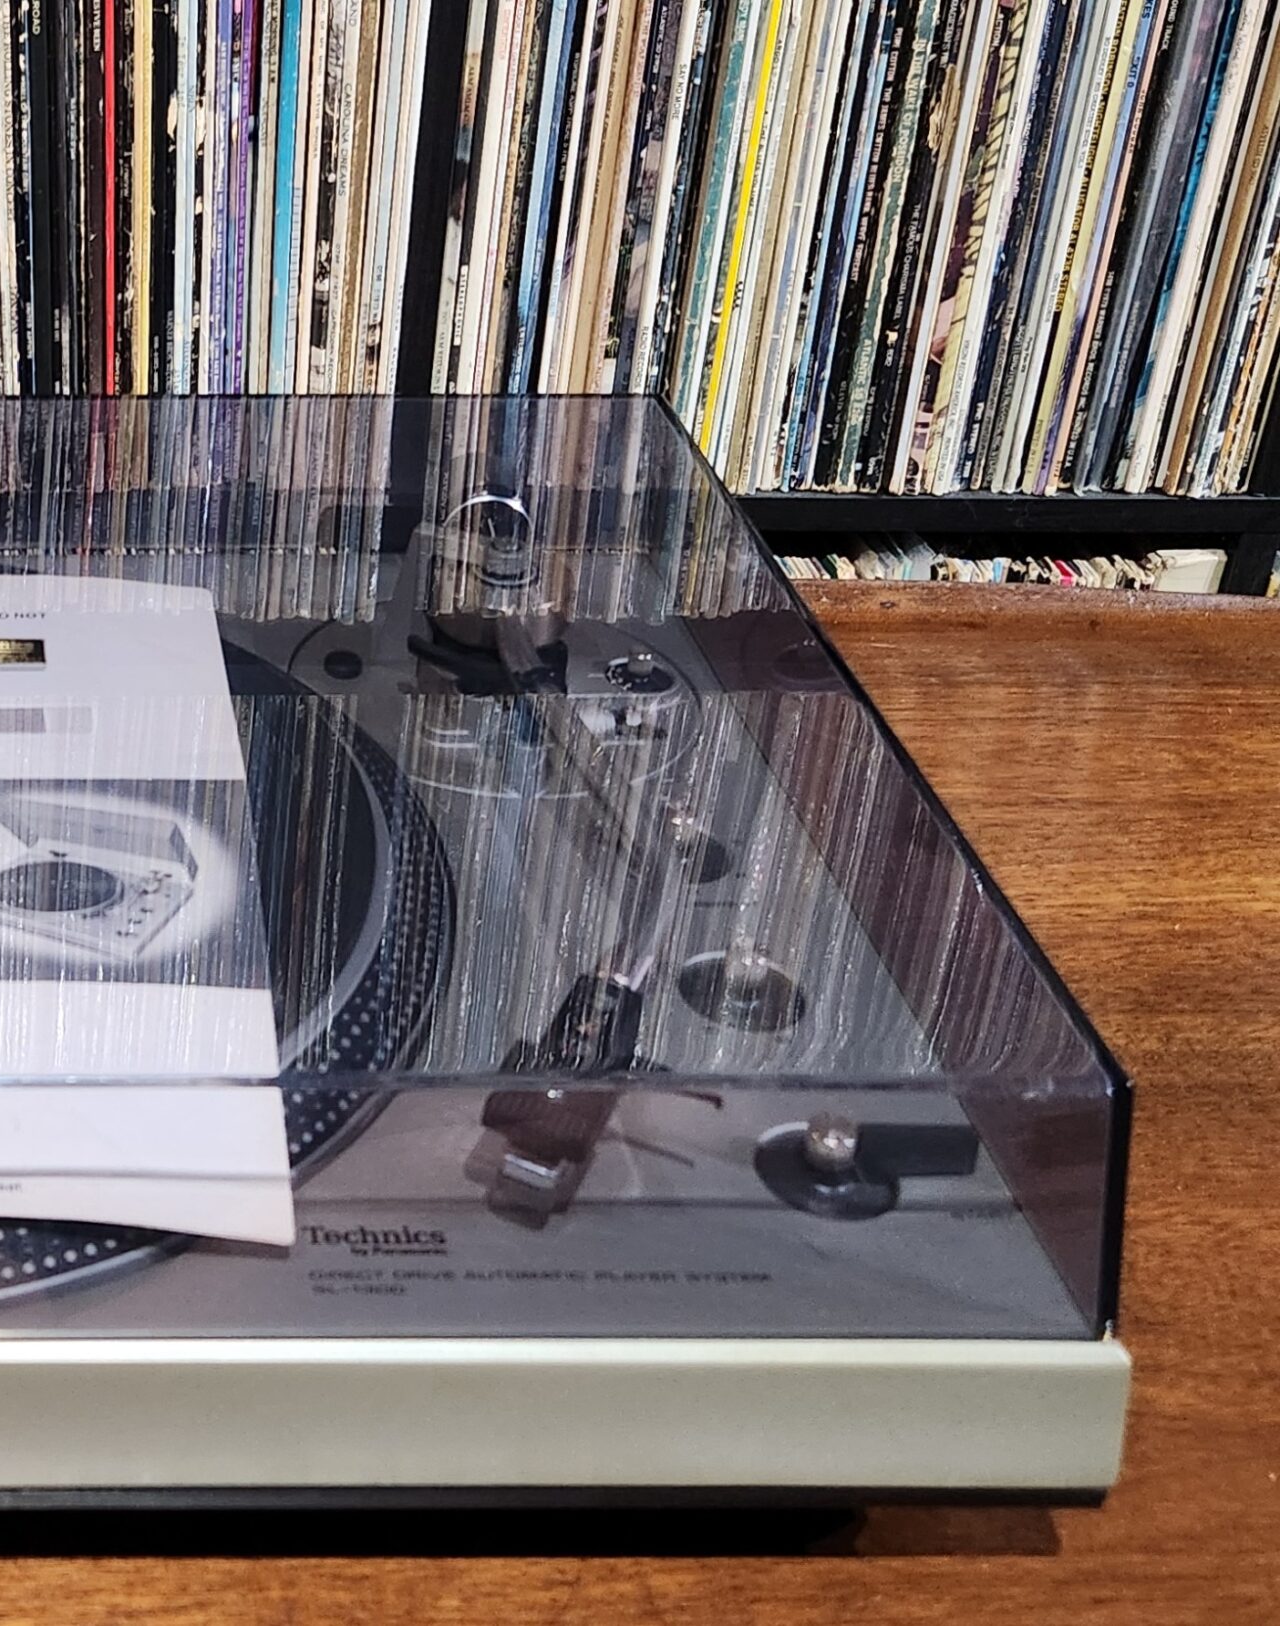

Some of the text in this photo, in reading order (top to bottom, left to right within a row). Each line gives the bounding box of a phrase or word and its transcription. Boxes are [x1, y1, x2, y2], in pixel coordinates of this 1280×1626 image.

[2, 15, 10, 39] THE
[32, 0, 40, 35] ROAD
[991, 13, 1005, 46] ACTION
[1114, 0, 1128, 34] ENTON
[1160, 0, 1179, 49] OUND TRACK
[3, 43, 12, 96] ROLLING
[910, 55, 924, 76] THE
[1100, 38, 1120, 94] ROBINSON
[671, 63, 687, 119] SAY NO MORE
[904, 79, 920, 109] WAKE
[4, 101, 13, 147] STONES
[901, 112, 913, 126] OF
[1084, 101, 1106, 169] NIGHTFLIGHT
[338, 83, 352, 195] CAROLINA DREAMS
[891, 129, 911, 182] POSEIDON
[1071, 176, 1090, 230] ALLIGATOR
[893, 204, 921, 319] THE FAMOUS CHARISMA LABEL
[1053, 273, 1069, 311] STEREO
[329, 309, 337, 354] CAPRICORN
[639, 326, 648, 350] RADIO
[1093, 309, 1106, 338] WARNER
[855, 338, 872, 385] ATLANTIC
[955, 362, 966, 389] RECORDS
[1079, 362, 1094, 396] RECORDS
[1069, 412, 1083, 439] PRINTED
[14, 612, 47, 620] NOT
[300, 1224, 448, 1246] Technics
